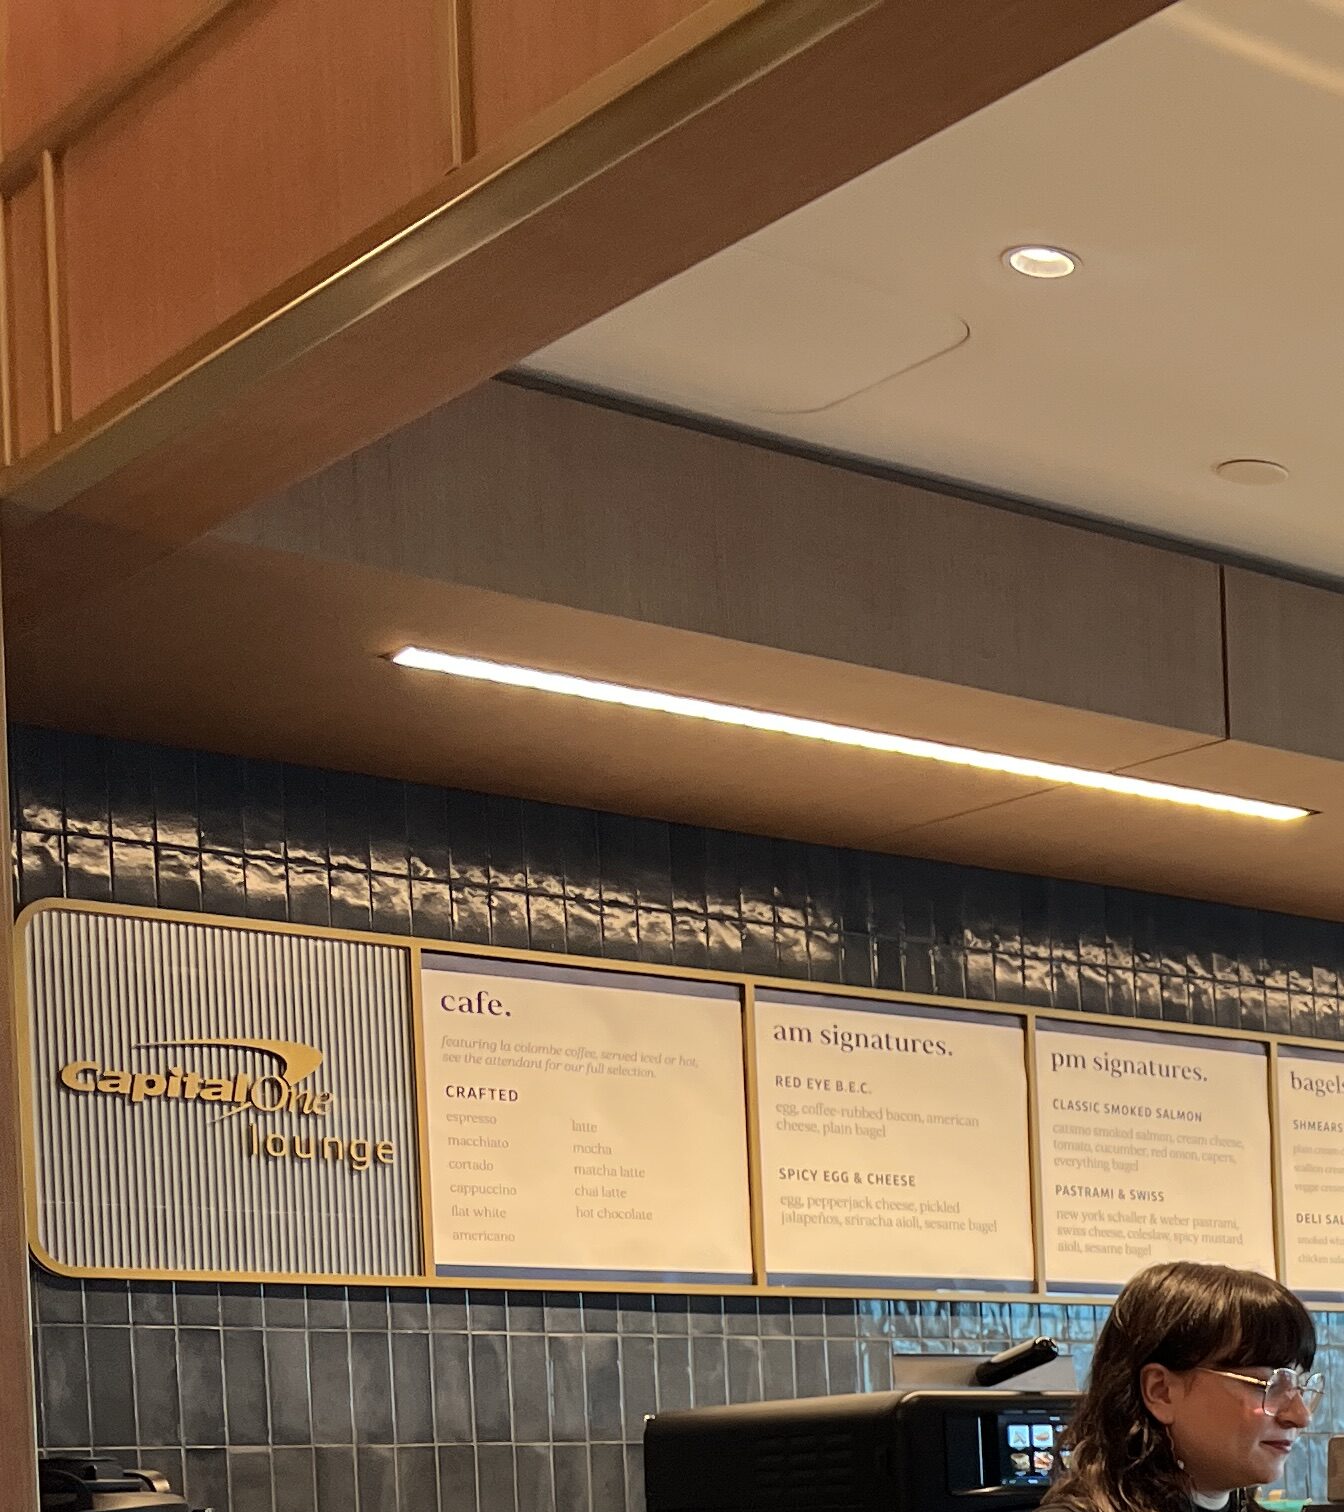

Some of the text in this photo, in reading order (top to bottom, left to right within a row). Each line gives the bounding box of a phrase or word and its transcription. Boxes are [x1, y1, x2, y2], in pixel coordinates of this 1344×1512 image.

[440, 990, 512, 1018] cafe.
[773, 1024, 954, 1056] am signatures.
[441, 1034, 699, 1069] featuring la colombe coffee, served iced or hot,
[442, 1052, 657, 1079] see the attendant for our full selection.
[1051, 1052, 1208, 1083] pm signatures.
[60, 1061, 248, 1103] Capital
[775, 1075, 873, 1095] RED EYE B.E.C.
[445, 1085, 519, 1102] CRAFTED
[446, 1112, 497, 1126] espresso
[775, 1102, 980, 1128] egg, coffee-rubbed bacon, american
[1052, 1098, 1203, 1123] CLASSIC SMOKED SALMON
[571, 1119, 598, 1133] latte
[775, 1118, 887, 1140] cheese, plain bagel
[1293, 1119, 1344, 1134] SHMEARS
[249, 1120, 395, 1172] lounge
[448, 1135, 509, 1149] macchiato
[1093, 1125, 1134, 1140] smoked
[1135, 1130, 1176, 1144] salmon,
[1176, 1134, 1208, 1146] cream
[1209, 1135, 1245, 1150] cheese,
[572, 1143, 613, 1156] mocha
[1053, 1140, 1238, 1166] tomato, cucumber, red onion, capers,
[448, 1159, 494, 1172] cortado
[573, 1164, 646, 1179] matcha latte
[1053, 1157, 1139, 1174] everything bagel
[778, 1167, 917, 1187] SPICY EGG & CHEESE
[449, 1183, 518, 1197] cappuccino
[574, 1185, 628, 1199] chai latte
[1055, 1184, 1165, 1203] PASTRAMI & SWISS
[451, 1205, 507, 1219] flat white
[576, 1206, 653, 1221] hot chocolate
[780, 1196, 961, 1215] egg, pepperjack cheese, pickled
[781, 1210, 998, 1235] jalapeños, sriracha aioli, sesame bagel
[1056, 1209, 1240, 1231] new york schaller & weber pastrami,
[1296, 1212, 1322, 1225] DELI
[452, 1230, 516, 1243] americano
[1057, 1225, 1244, 1246] swiss cheese, coleslaw, spicy mustard
[1084, 1243, 1124, 1256] sesame
[1124, 1244, 1152, 1259] bagel
